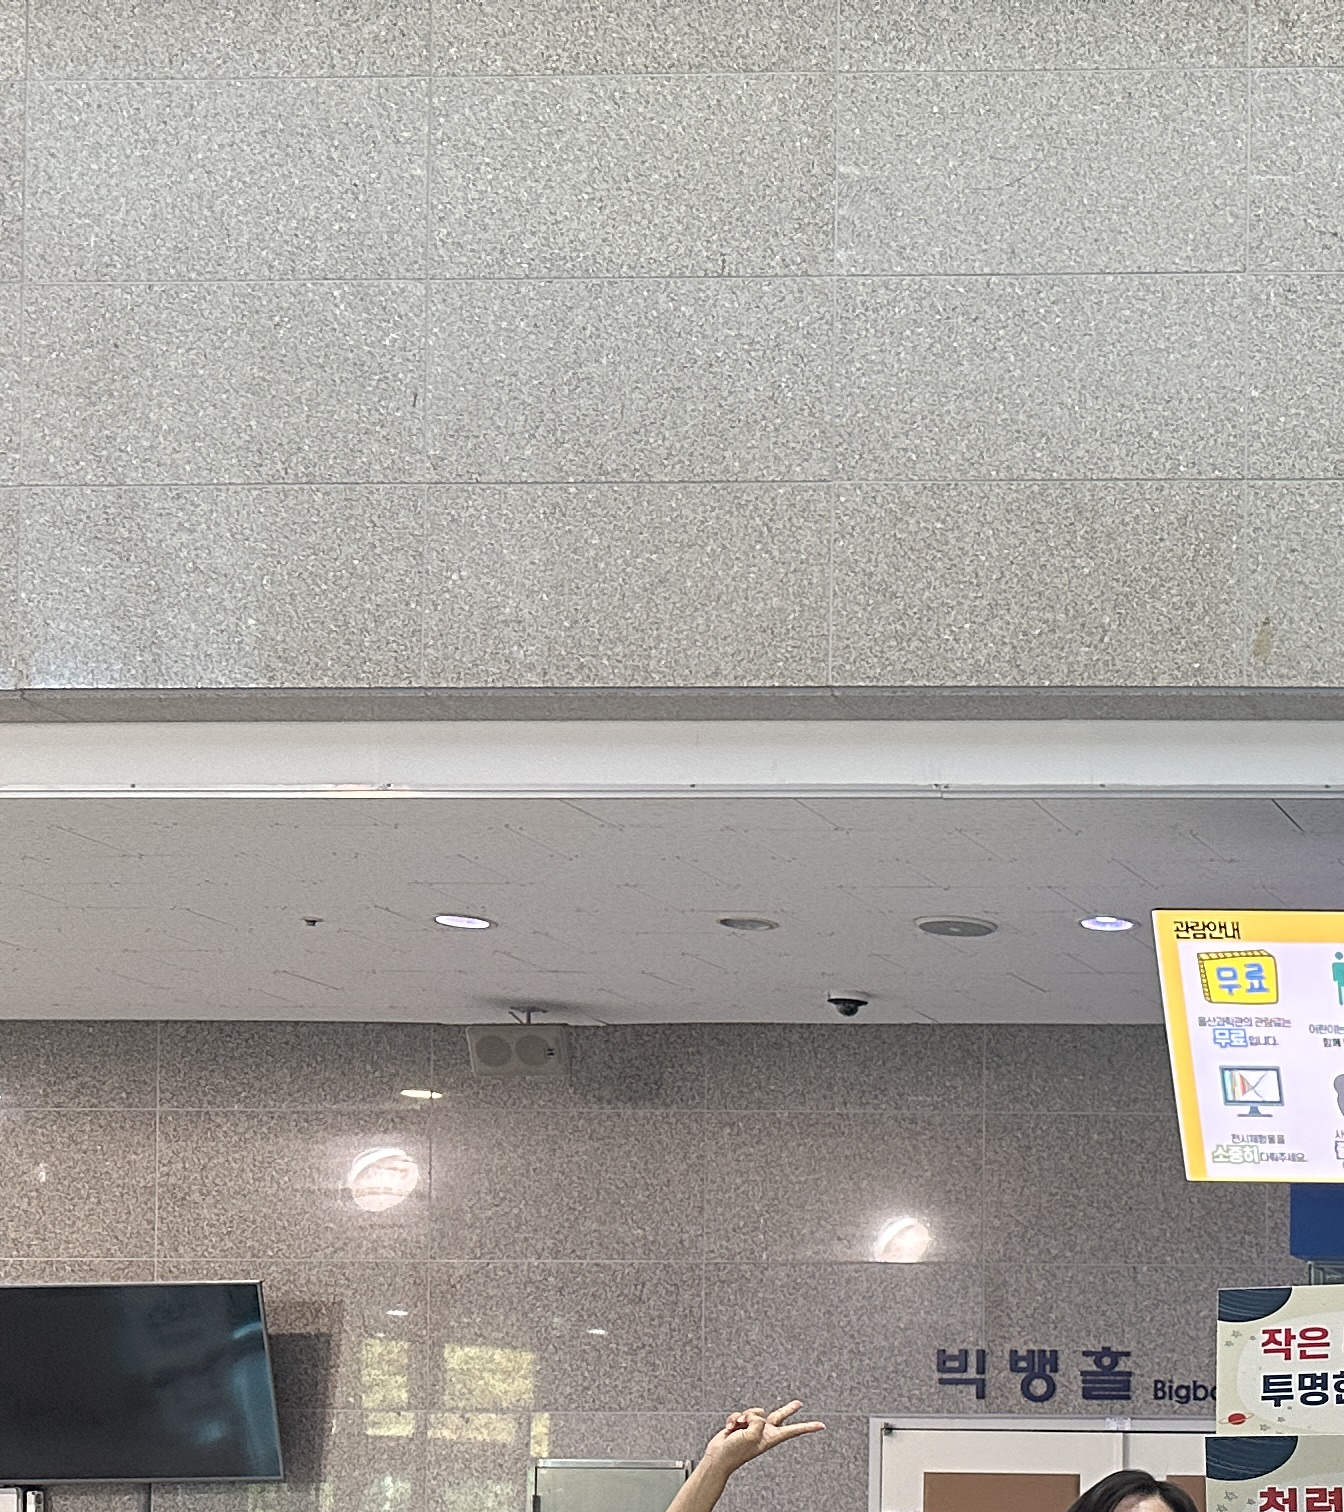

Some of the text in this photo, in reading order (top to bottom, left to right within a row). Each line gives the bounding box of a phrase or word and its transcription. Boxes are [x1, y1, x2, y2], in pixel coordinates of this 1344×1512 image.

[1173, 920, 1241, 940] 관람안내
[1216, 963, 1270, 996] 무료
[1260, 1326, 1332, 1359] 작은
